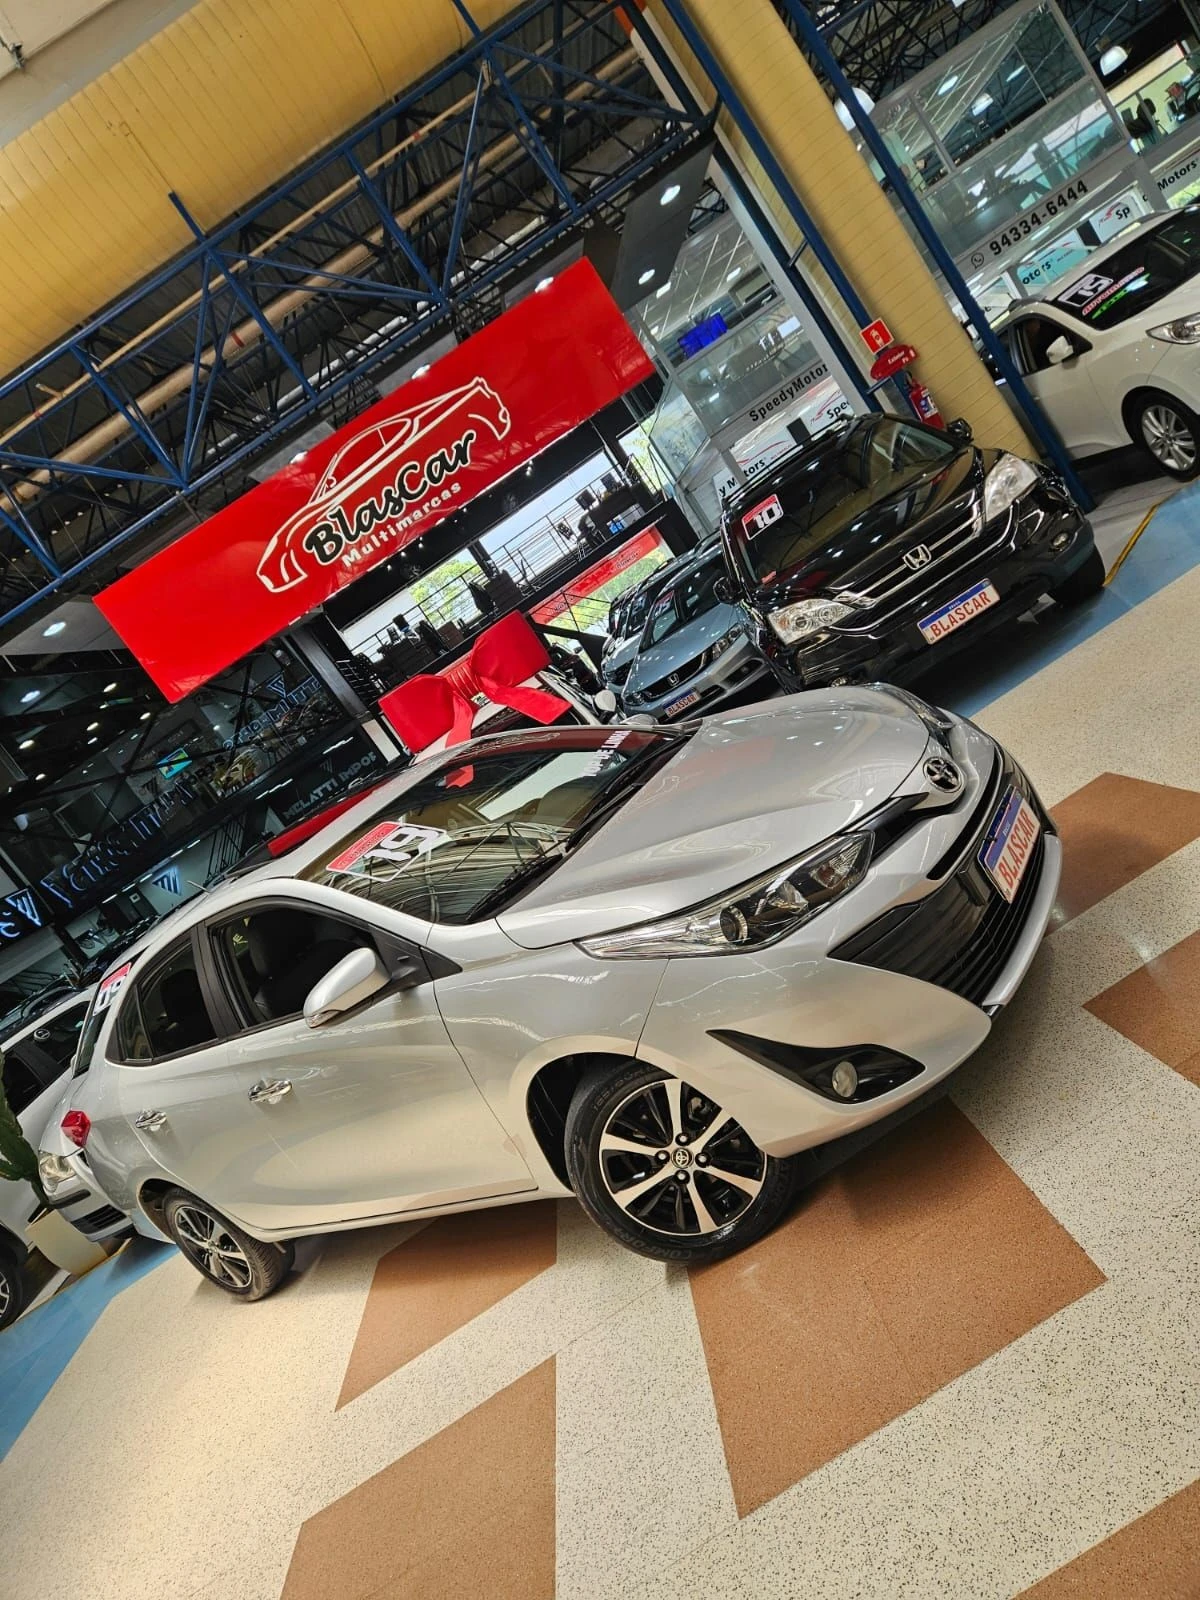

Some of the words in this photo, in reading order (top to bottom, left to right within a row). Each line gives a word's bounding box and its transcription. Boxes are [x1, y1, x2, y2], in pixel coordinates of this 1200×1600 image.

[990, 180, 1088, 256] 94334-6444
[303, 430, 476, 565] BlasCar
[344, 481, 461, 567] Multimarcas
[754, 502, 782, 529] 10
[930, 591, 992, 638] BLASCAR
[667, 694, 697, 715] BLASCAR
[364, 826, 441, 863] 19
[995, 807, 1038, 889] BLASCAR
